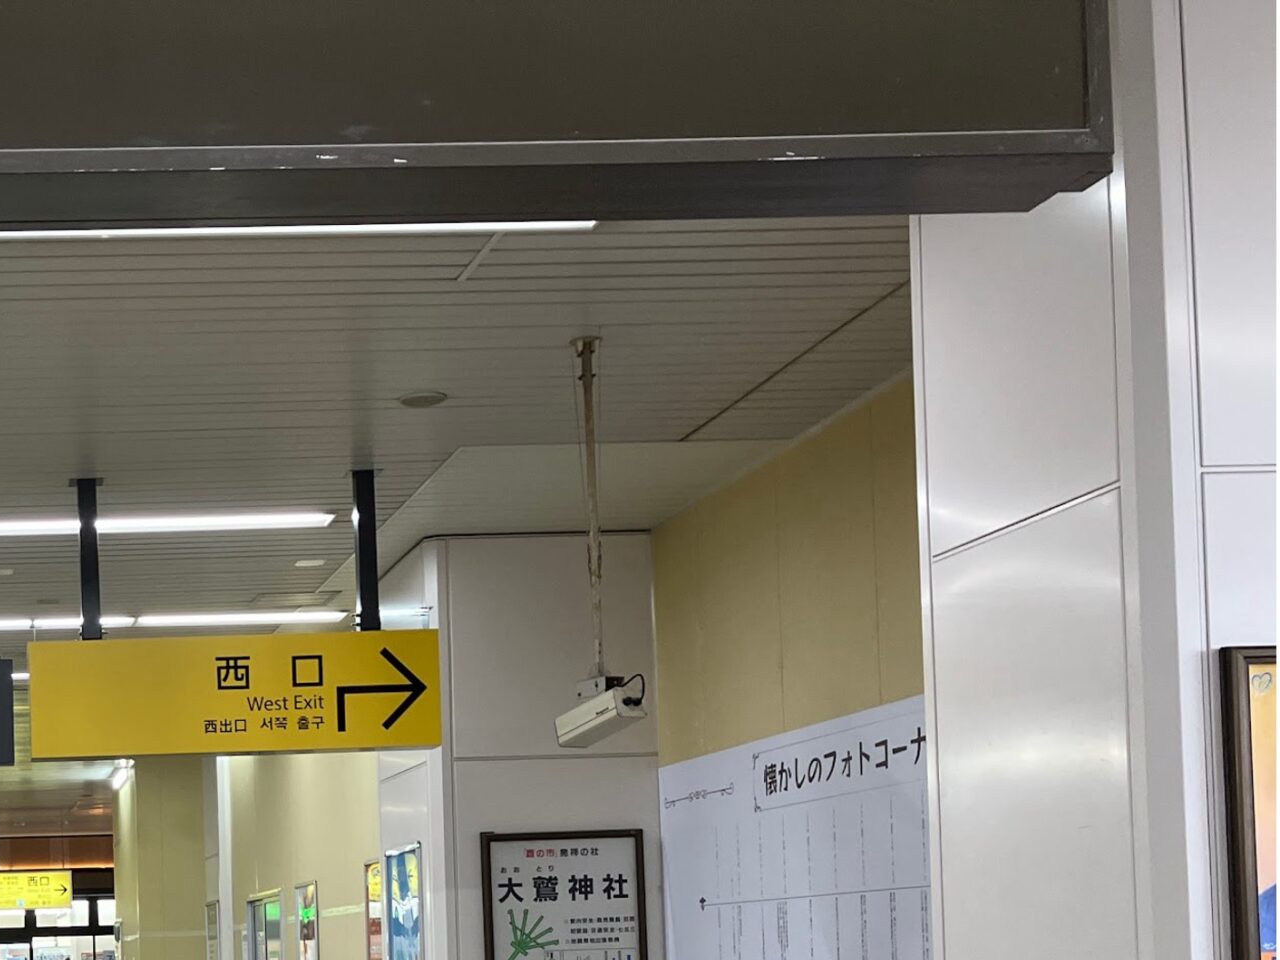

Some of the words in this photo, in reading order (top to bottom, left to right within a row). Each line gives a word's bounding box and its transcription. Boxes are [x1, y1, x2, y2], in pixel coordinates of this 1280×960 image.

[215, 654, 323, 690] 西口
[247, 696, 288, 711] West
[294, 694, 324, 710] Exit
[204, 718, 247, 734] 西出口
[260, 716, 287, 731] 서쪽
[297, 715, 325, 730] 출구
[498, 873, 629, 903] 大鷲神社
